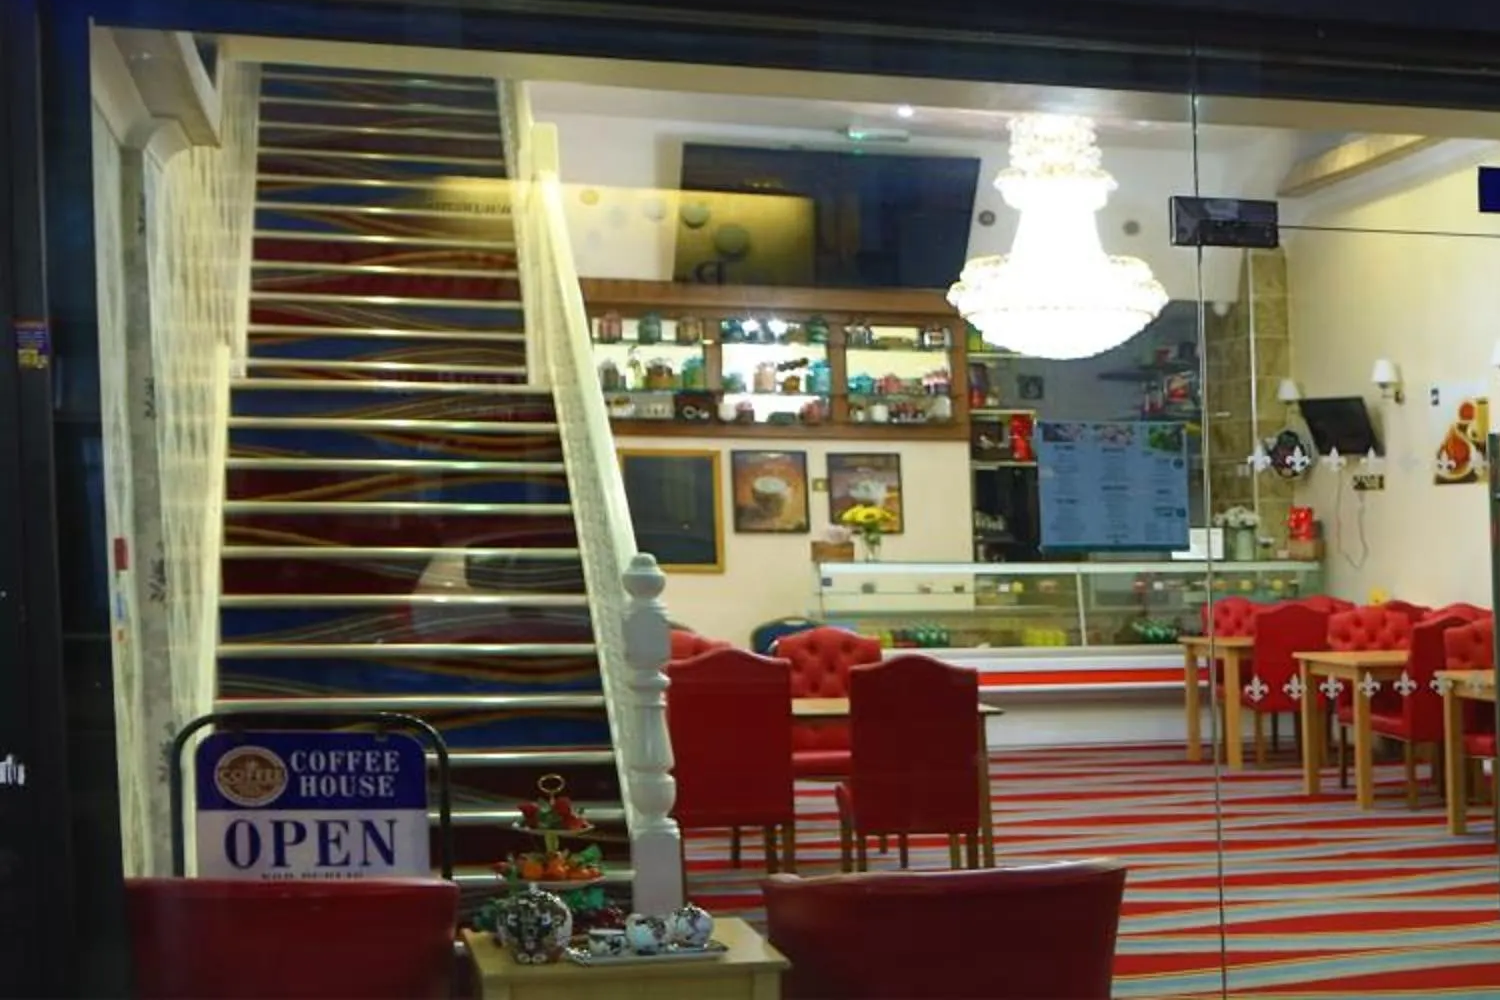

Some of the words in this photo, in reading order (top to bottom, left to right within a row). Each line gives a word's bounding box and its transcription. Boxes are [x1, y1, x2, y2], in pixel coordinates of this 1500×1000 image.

[291, 750, 400, 773] COFFEE
[300, 774, 396, 798] HOUSE
[223, 818, 399, 870] OPEN
